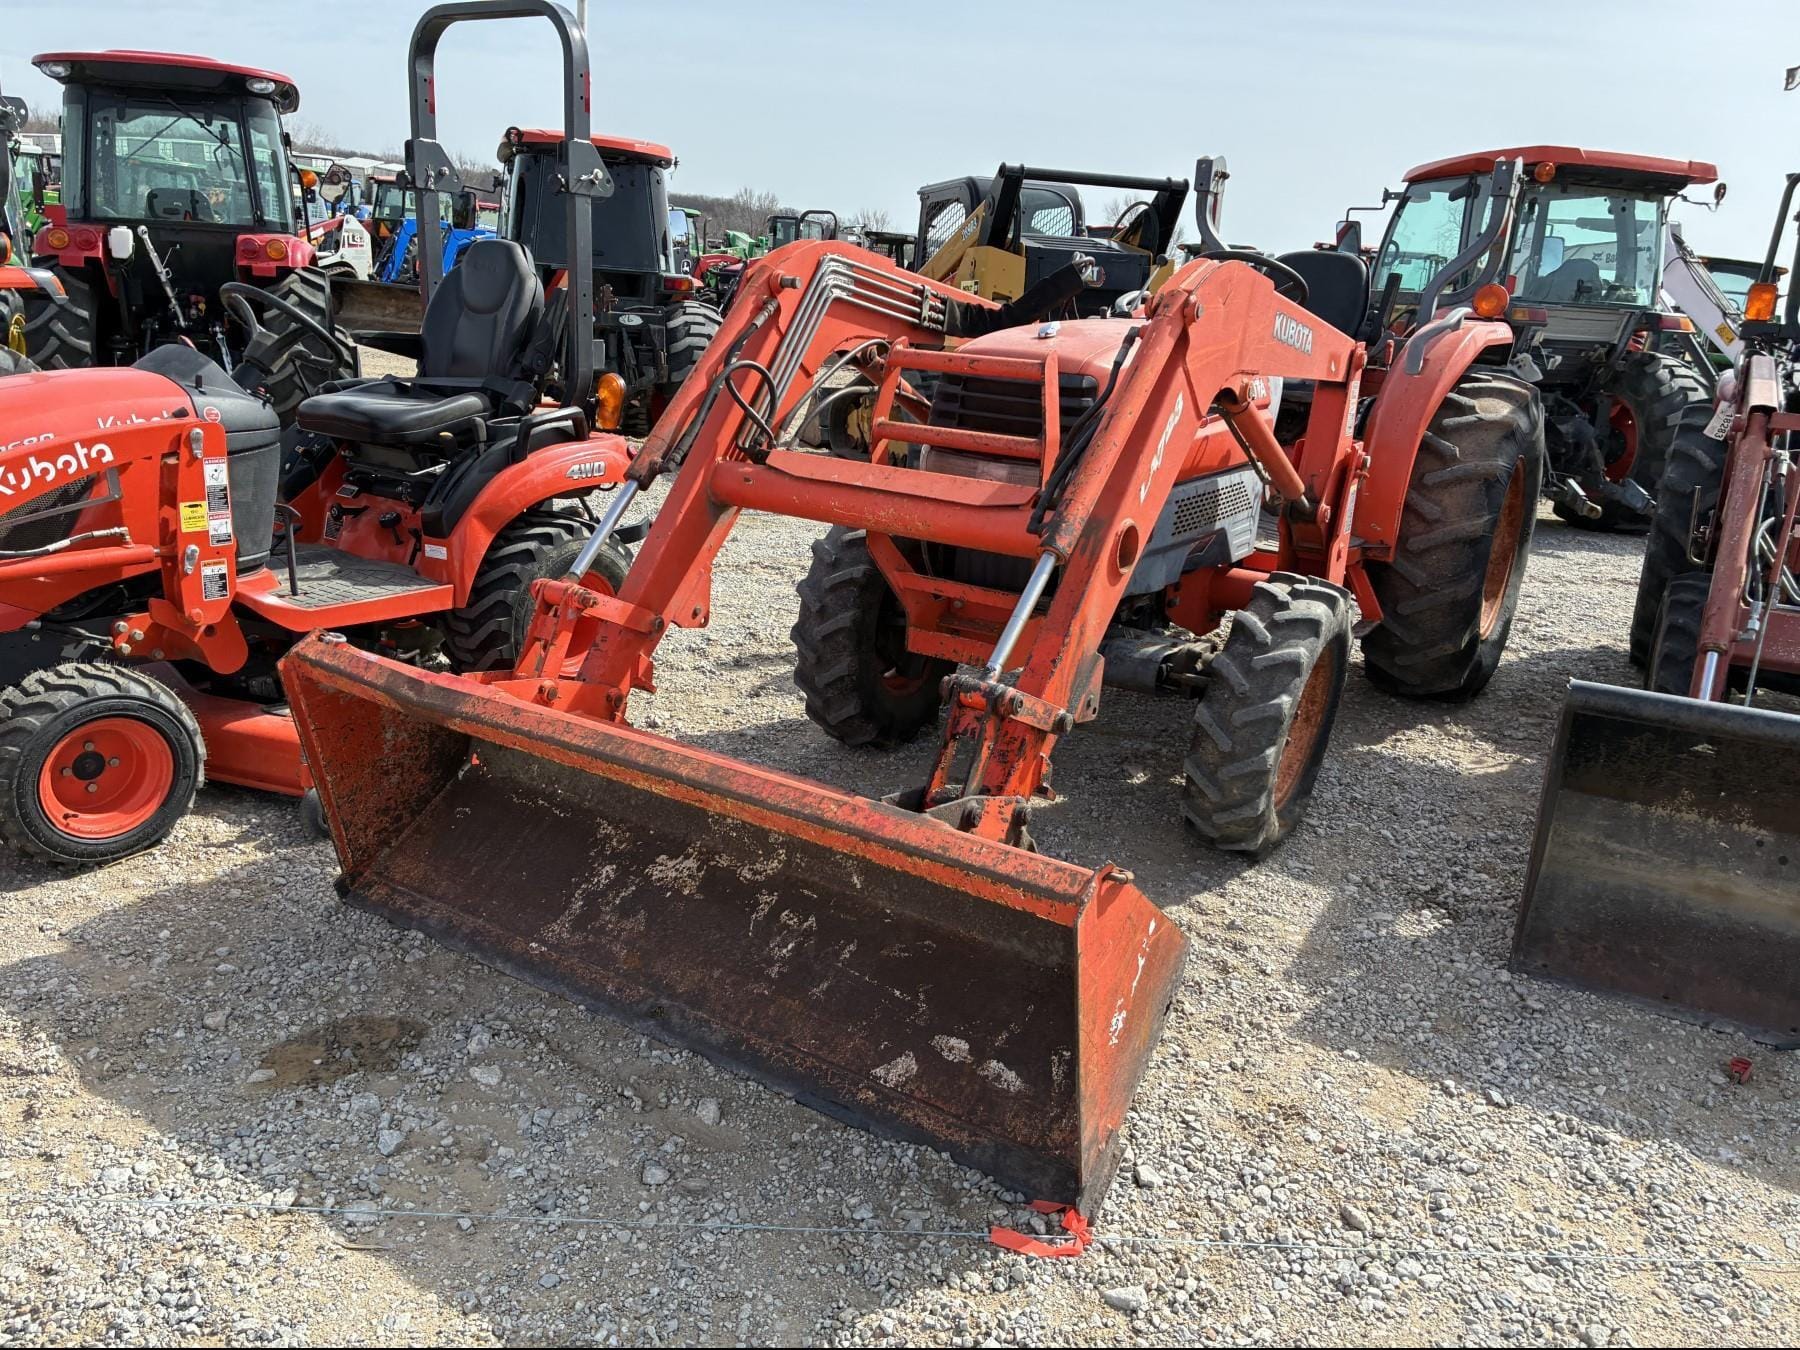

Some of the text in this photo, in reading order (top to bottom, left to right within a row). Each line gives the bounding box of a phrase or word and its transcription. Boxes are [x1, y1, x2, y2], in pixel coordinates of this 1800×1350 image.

[1273, 311, 1313, 355] KUBOTA
[1713, 412, 1733, 439] 18283
[566, 461, 606, 479] 4WD
